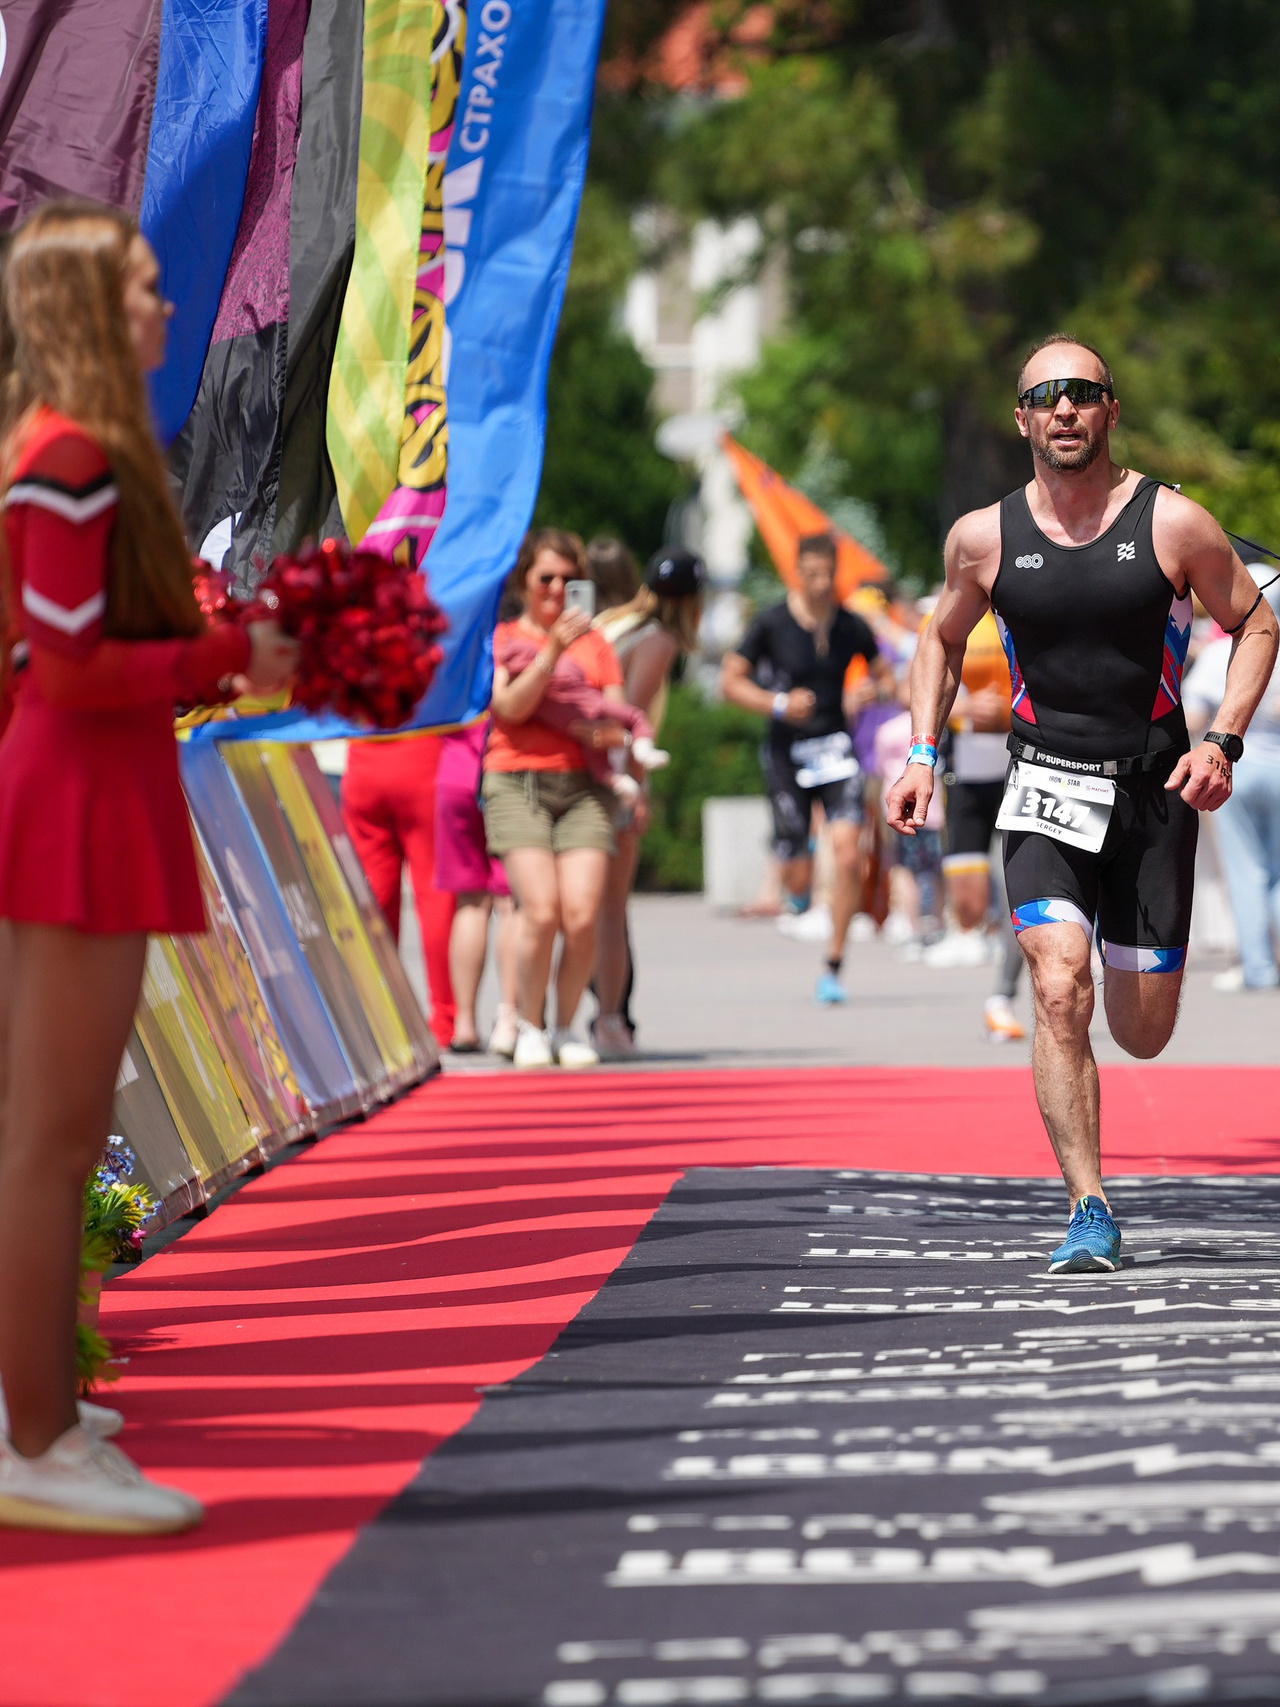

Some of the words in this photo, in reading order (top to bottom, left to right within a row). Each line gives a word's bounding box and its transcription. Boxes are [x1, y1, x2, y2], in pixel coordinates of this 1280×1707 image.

[1045, 754, 1102, 772] SUPERSPORT
[1021, 790, 1091, 829] 3147
[1036, 821, 1063, 835] SERGEY
